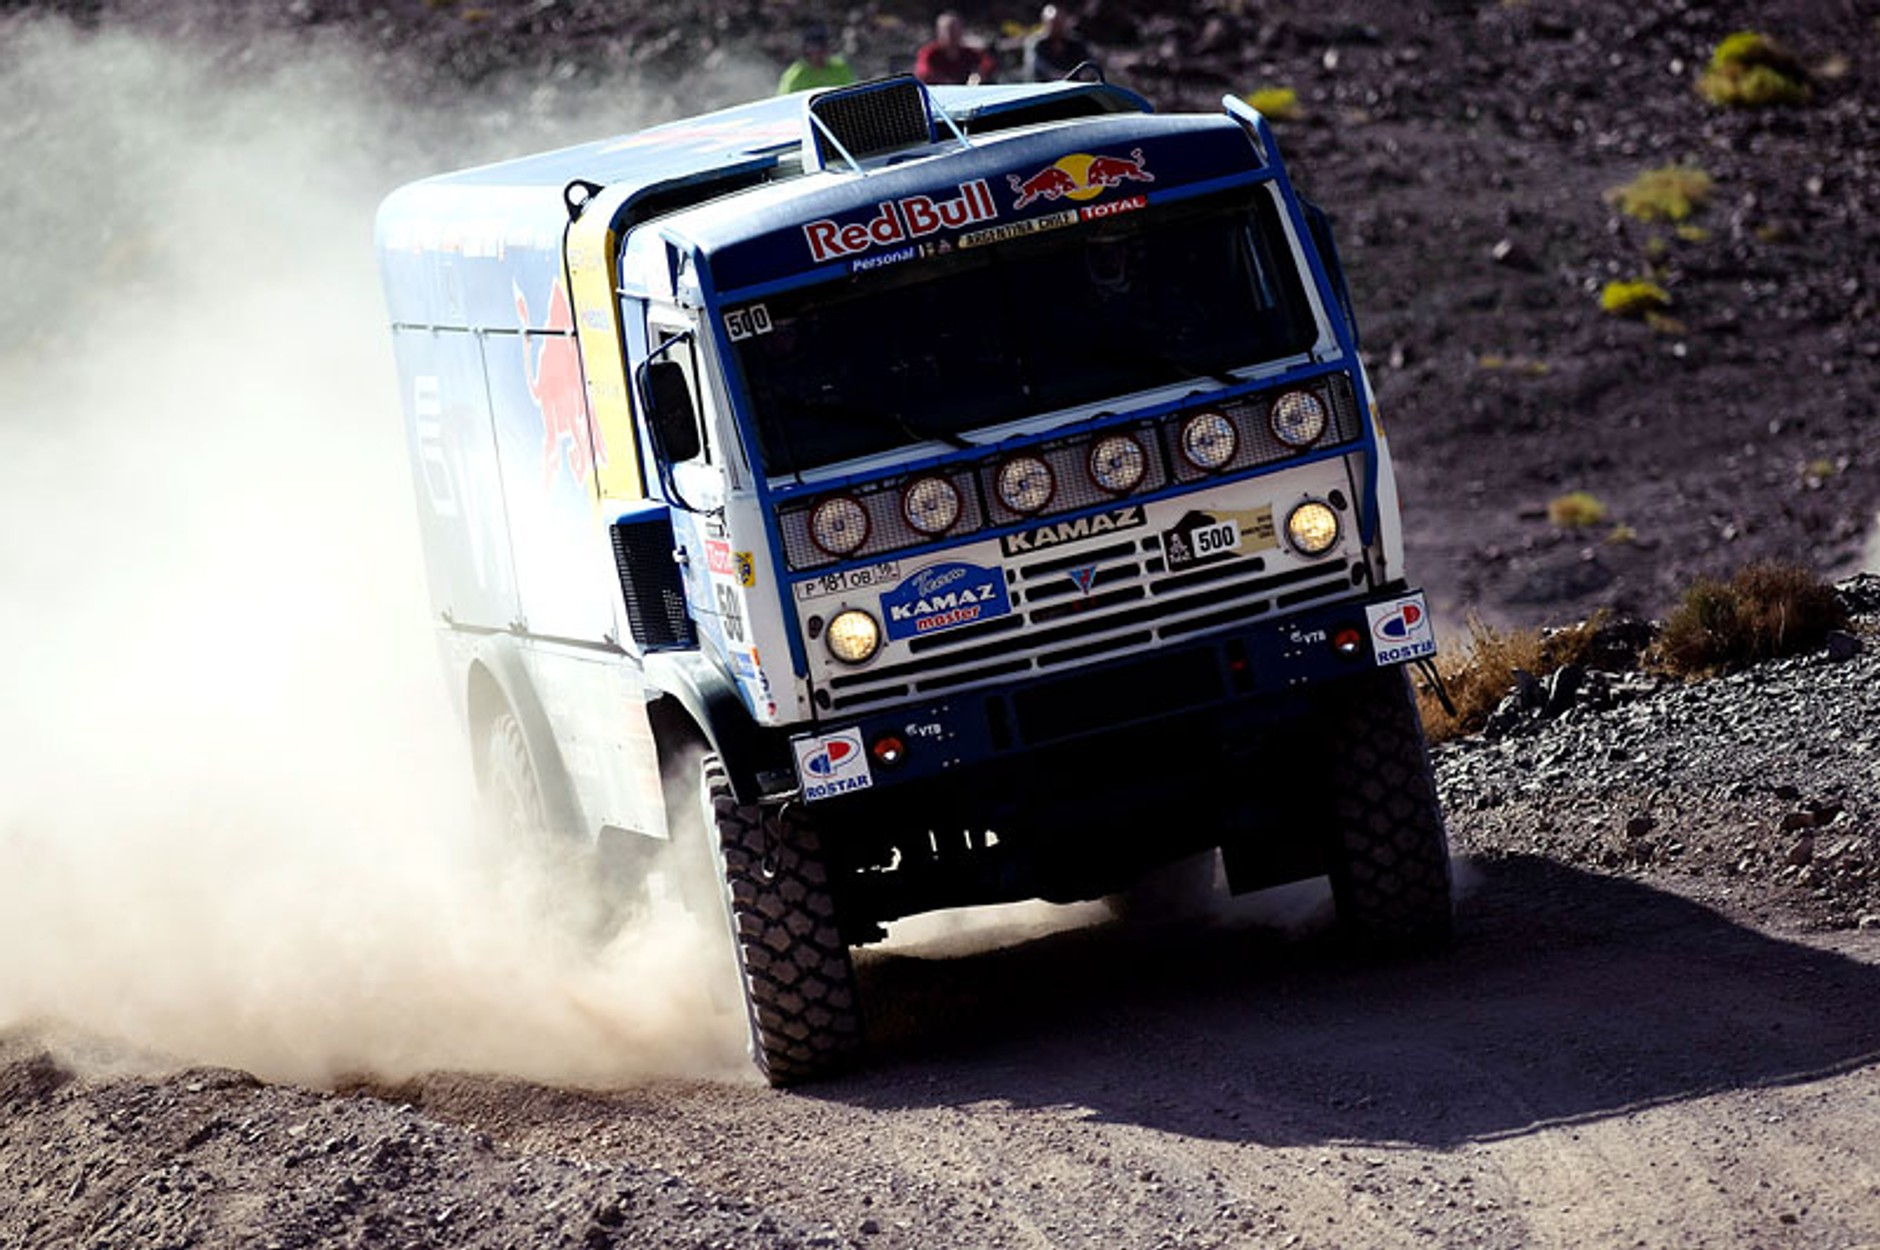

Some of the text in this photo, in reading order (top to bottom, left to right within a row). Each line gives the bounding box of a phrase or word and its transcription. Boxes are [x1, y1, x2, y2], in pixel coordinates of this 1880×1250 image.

[803, 179, 998, 262] Red Bull
[1086, 197, 1145, 219] TOTAL
[852, 246, 914, 272] Personal
[727, 308, 768, 337] 500
[1006, 508, 1139, 553] KAMAZ
[1198, 526, 1236, 552] 500
[890, 583, 996, 621] KAMAZ
[915, 605, 981, 631] master
[805, 775, 868, 798] ROSTAR
